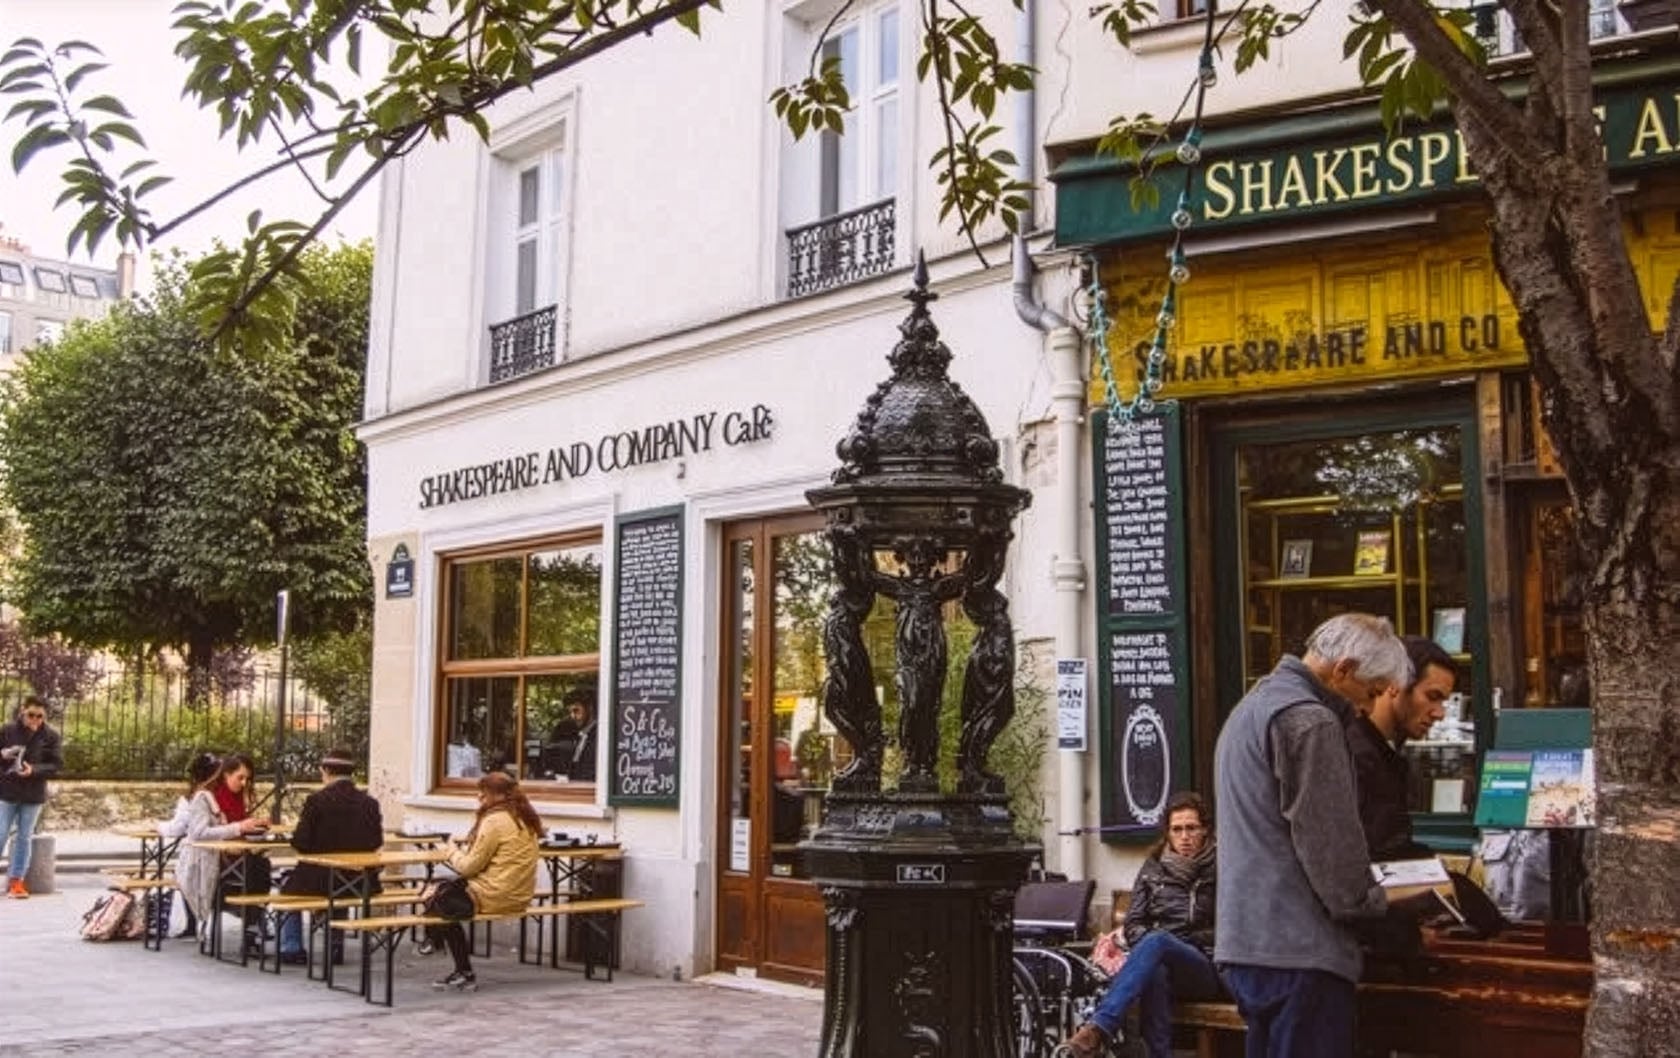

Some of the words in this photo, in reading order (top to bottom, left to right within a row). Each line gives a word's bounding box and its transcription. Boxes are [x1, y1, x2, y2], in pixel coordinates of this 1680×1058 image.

[1203, 104, 1607, 221] SHAKESPE
[1628, 94, 1680, 158] A
[1383, 320, 1446, 361] AND
[1459, 313, 1499, 353] CO
[419, 452, 540, 510] SHAKESPEARE
[542, 441, 593, 485] AND
[599, 411, 718, 474] COMPANY
